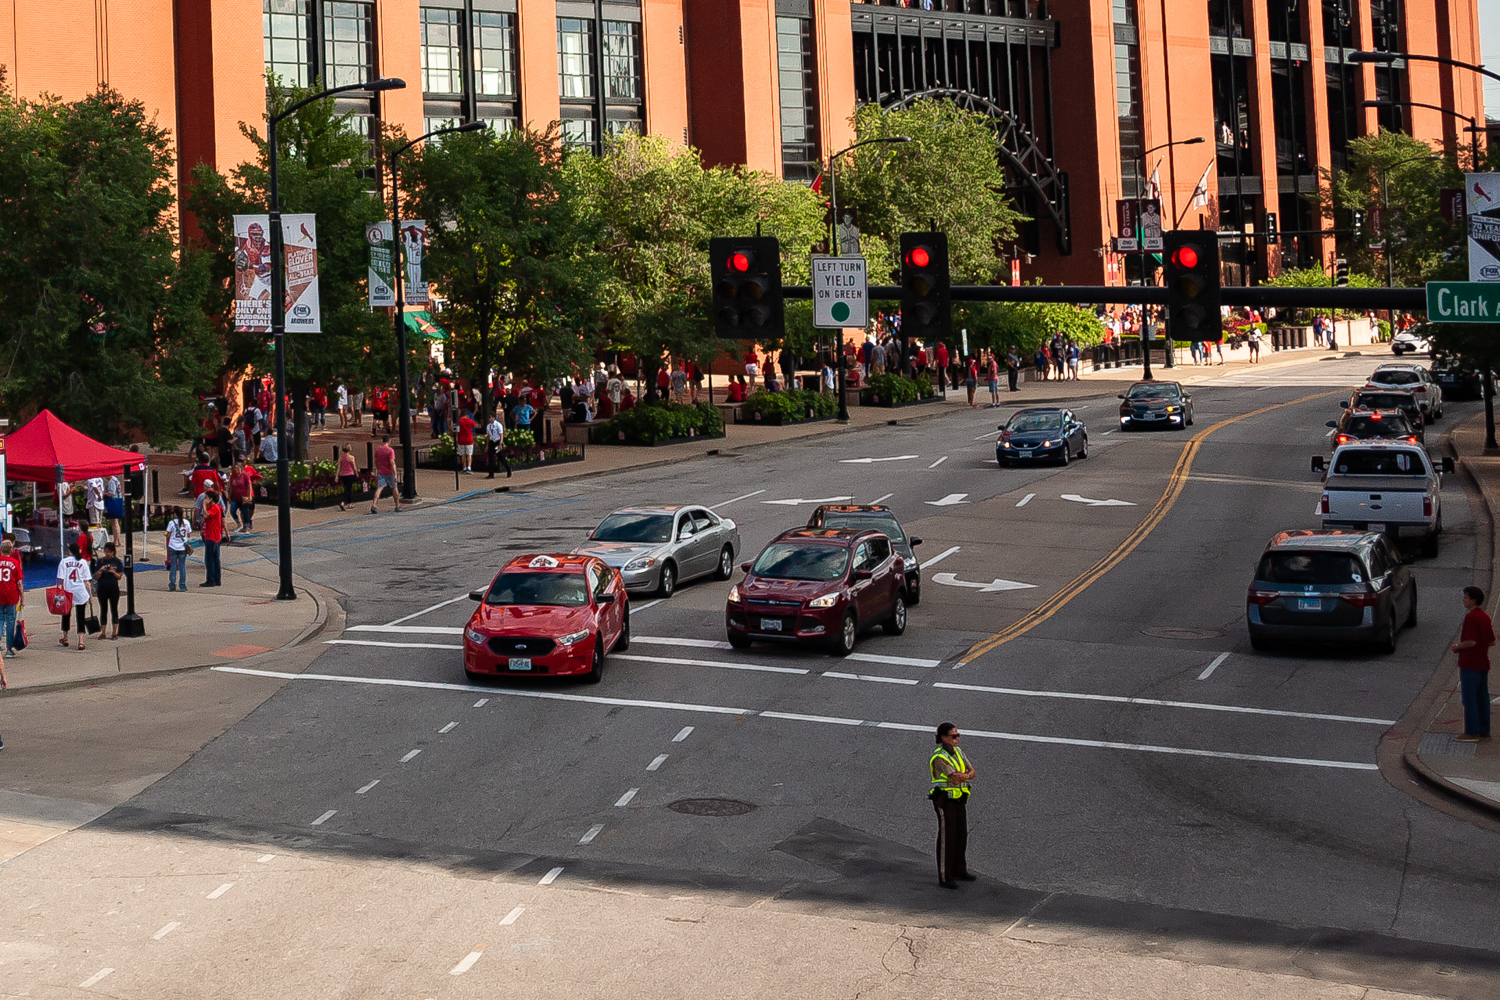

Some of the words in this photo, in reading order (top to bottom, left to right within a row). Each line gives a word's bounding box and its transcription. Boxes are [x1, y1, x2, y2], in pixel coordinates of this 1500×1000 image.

[288, 253, 314, 267] GLOVER
[817, 262, 837, 272] LEFT
[840, 262, 862, 272] TURN
[824, 275, 856, 287] YIELD
[818, 290, 830, 299] ON
[834, 289, 862, 299] GREEN
[235, 299, 272, 308] THERE'S
[1437, 287, 1490, 317] Clark
[68, 569, 77, 583] 4
